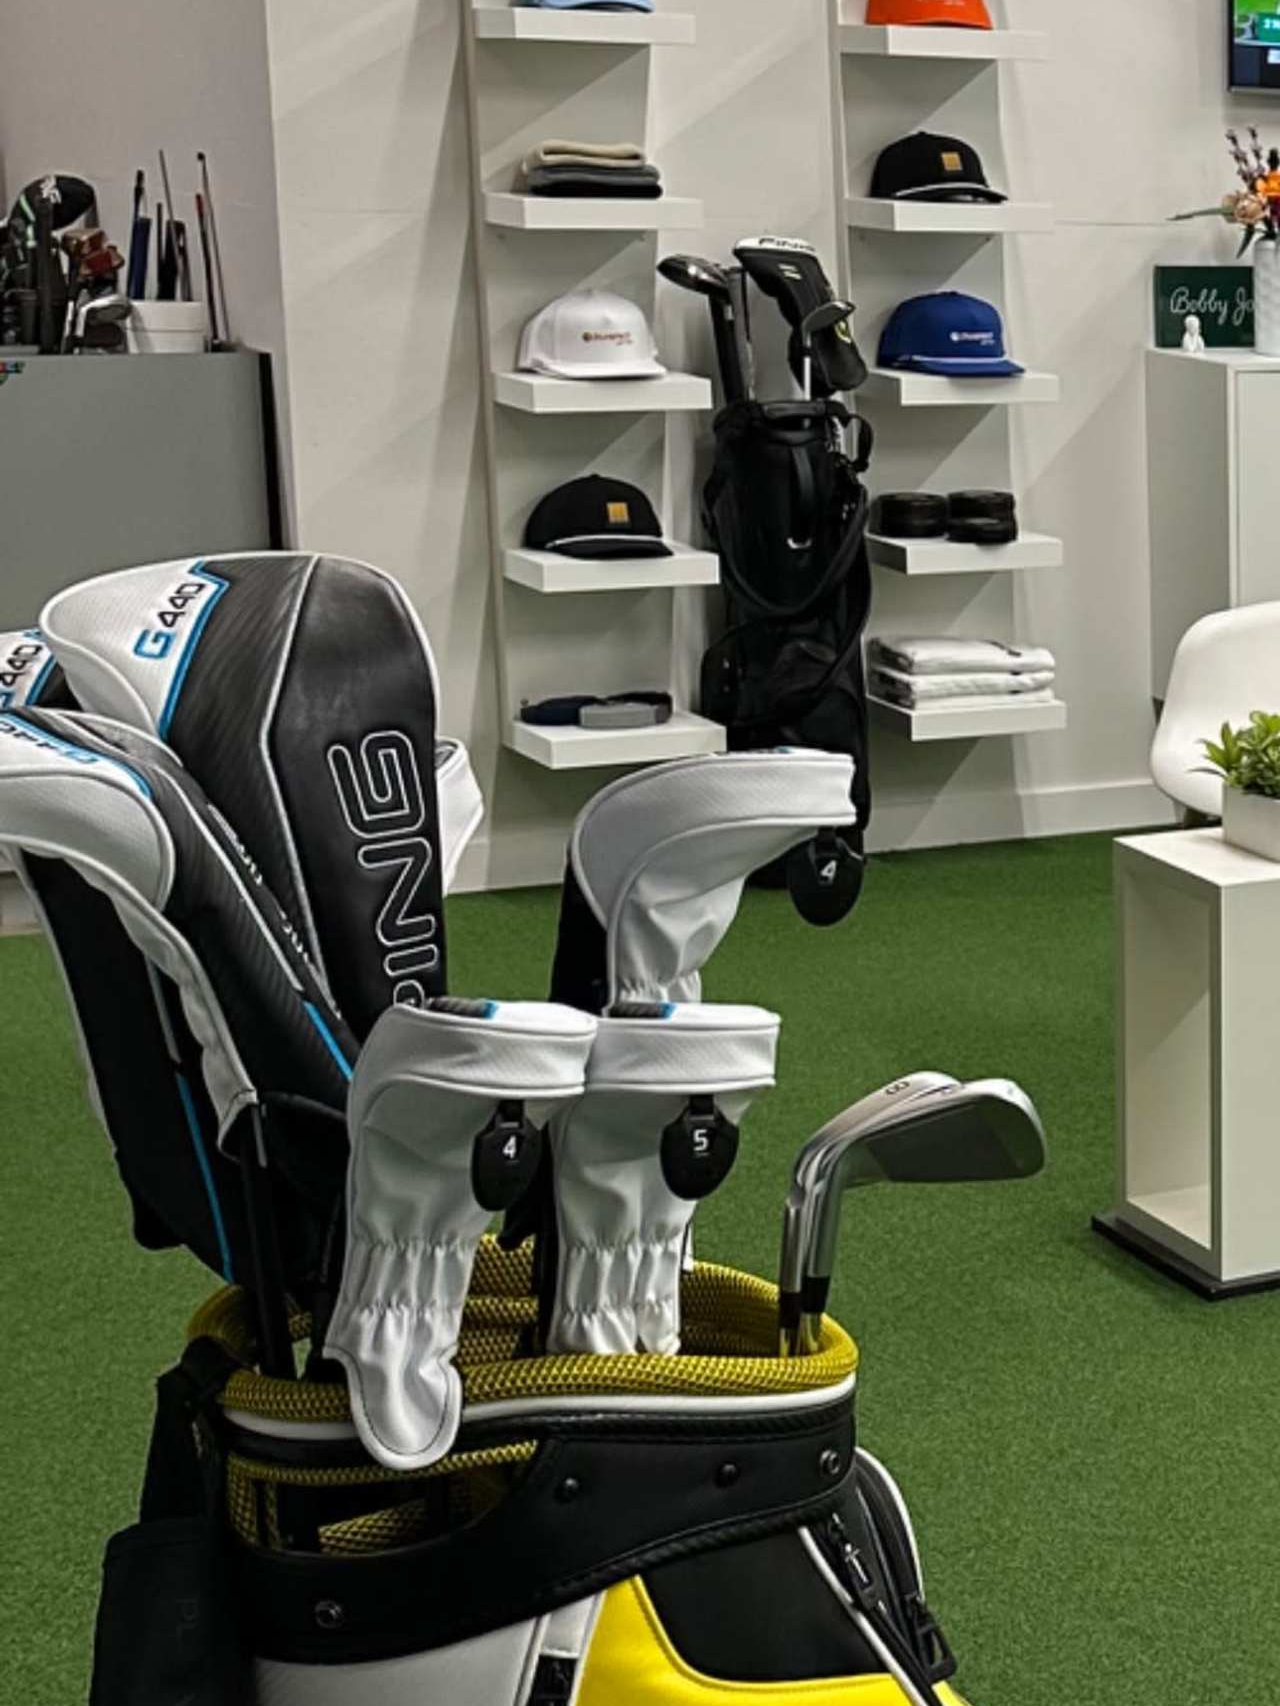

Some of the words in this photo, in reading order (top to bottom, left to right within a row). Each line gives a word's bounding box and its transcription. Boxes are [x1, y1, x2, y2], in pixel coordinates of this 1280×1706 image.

[1169, 286, 1229, 322] Bobby
[819, 860, 838, 883] 4
[502, 1133, 519, 1161] 4
[692, 1130, 709, 1153] 5
